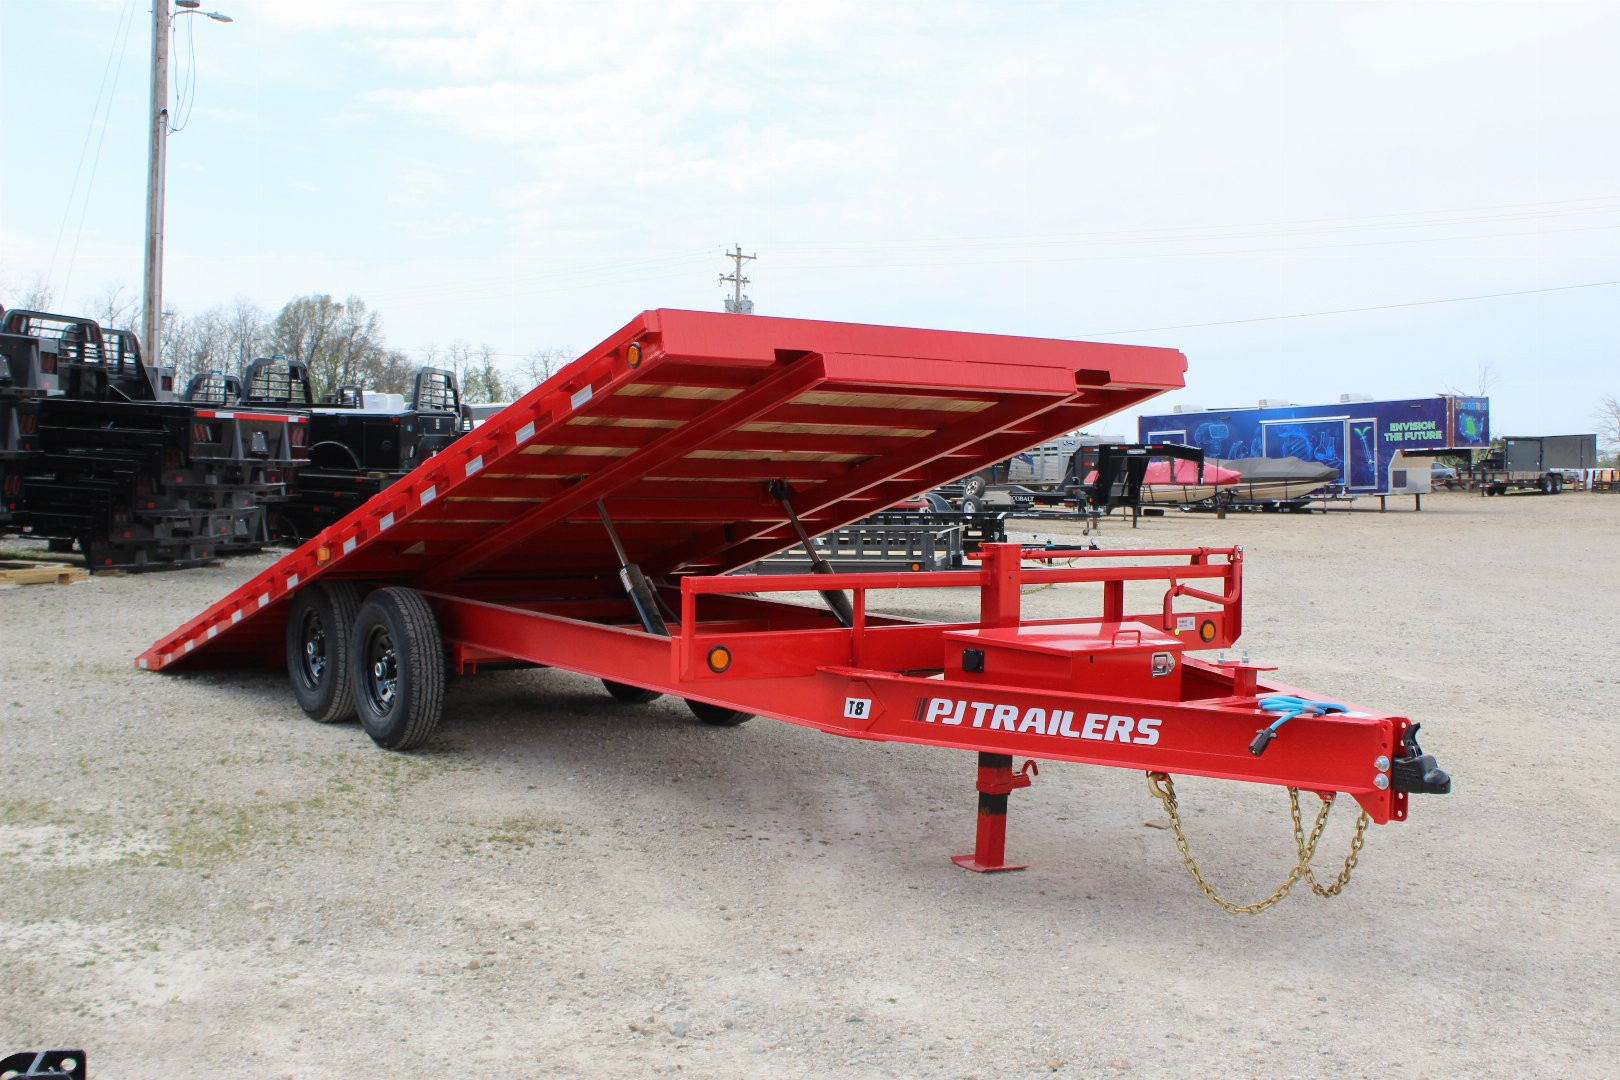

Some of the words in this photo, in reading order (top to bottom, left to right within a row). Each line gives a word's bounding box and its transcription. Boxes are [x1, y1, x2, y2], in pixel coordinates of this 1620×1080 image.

[1390, 421, 1435, 431] ENVISION
[1384, 432, 1402, 441] THE
[1404, 431, 1442, 440] FUTURE
[849, 700, 865, 716] T8
[925, 698, 967, 725] PJ
[970, 701, 1162, 745] TRAILERS
